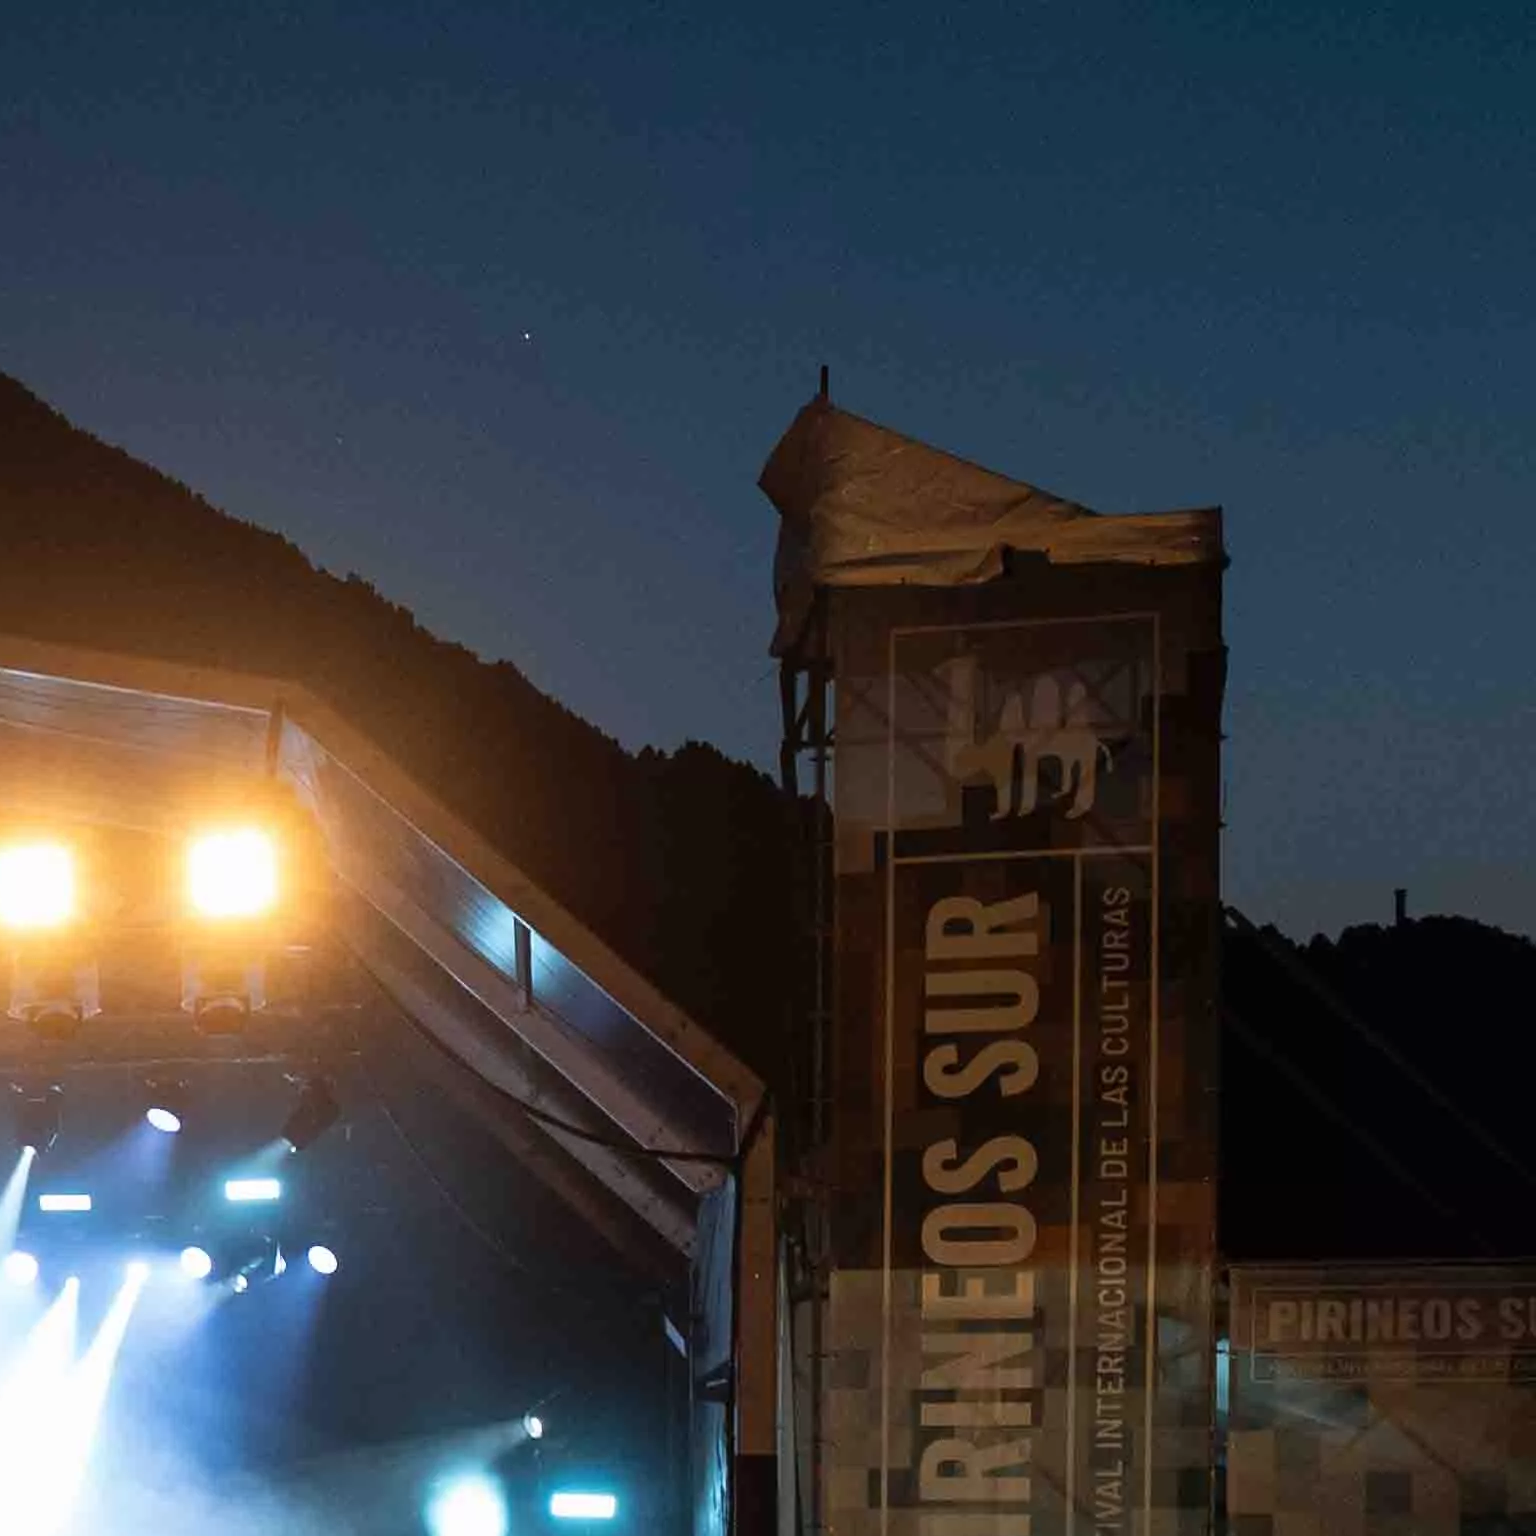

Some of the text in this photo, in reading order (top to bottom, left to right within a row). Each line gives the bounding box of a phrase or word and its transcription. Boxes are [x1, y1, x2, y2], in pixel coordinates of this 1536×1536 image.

[923, 891, 1040, 1098] SUR
[1102, 887, 1131, 1055] CULTURAS
[1101, 1064, 1129, 1128] LAS
[1100, 1138, 1128, 1180] DE
[1095, 1189, 1129, 1450] INTERNACIONAL
[1268, 1298, 1482, 1341] PIRINEOS
